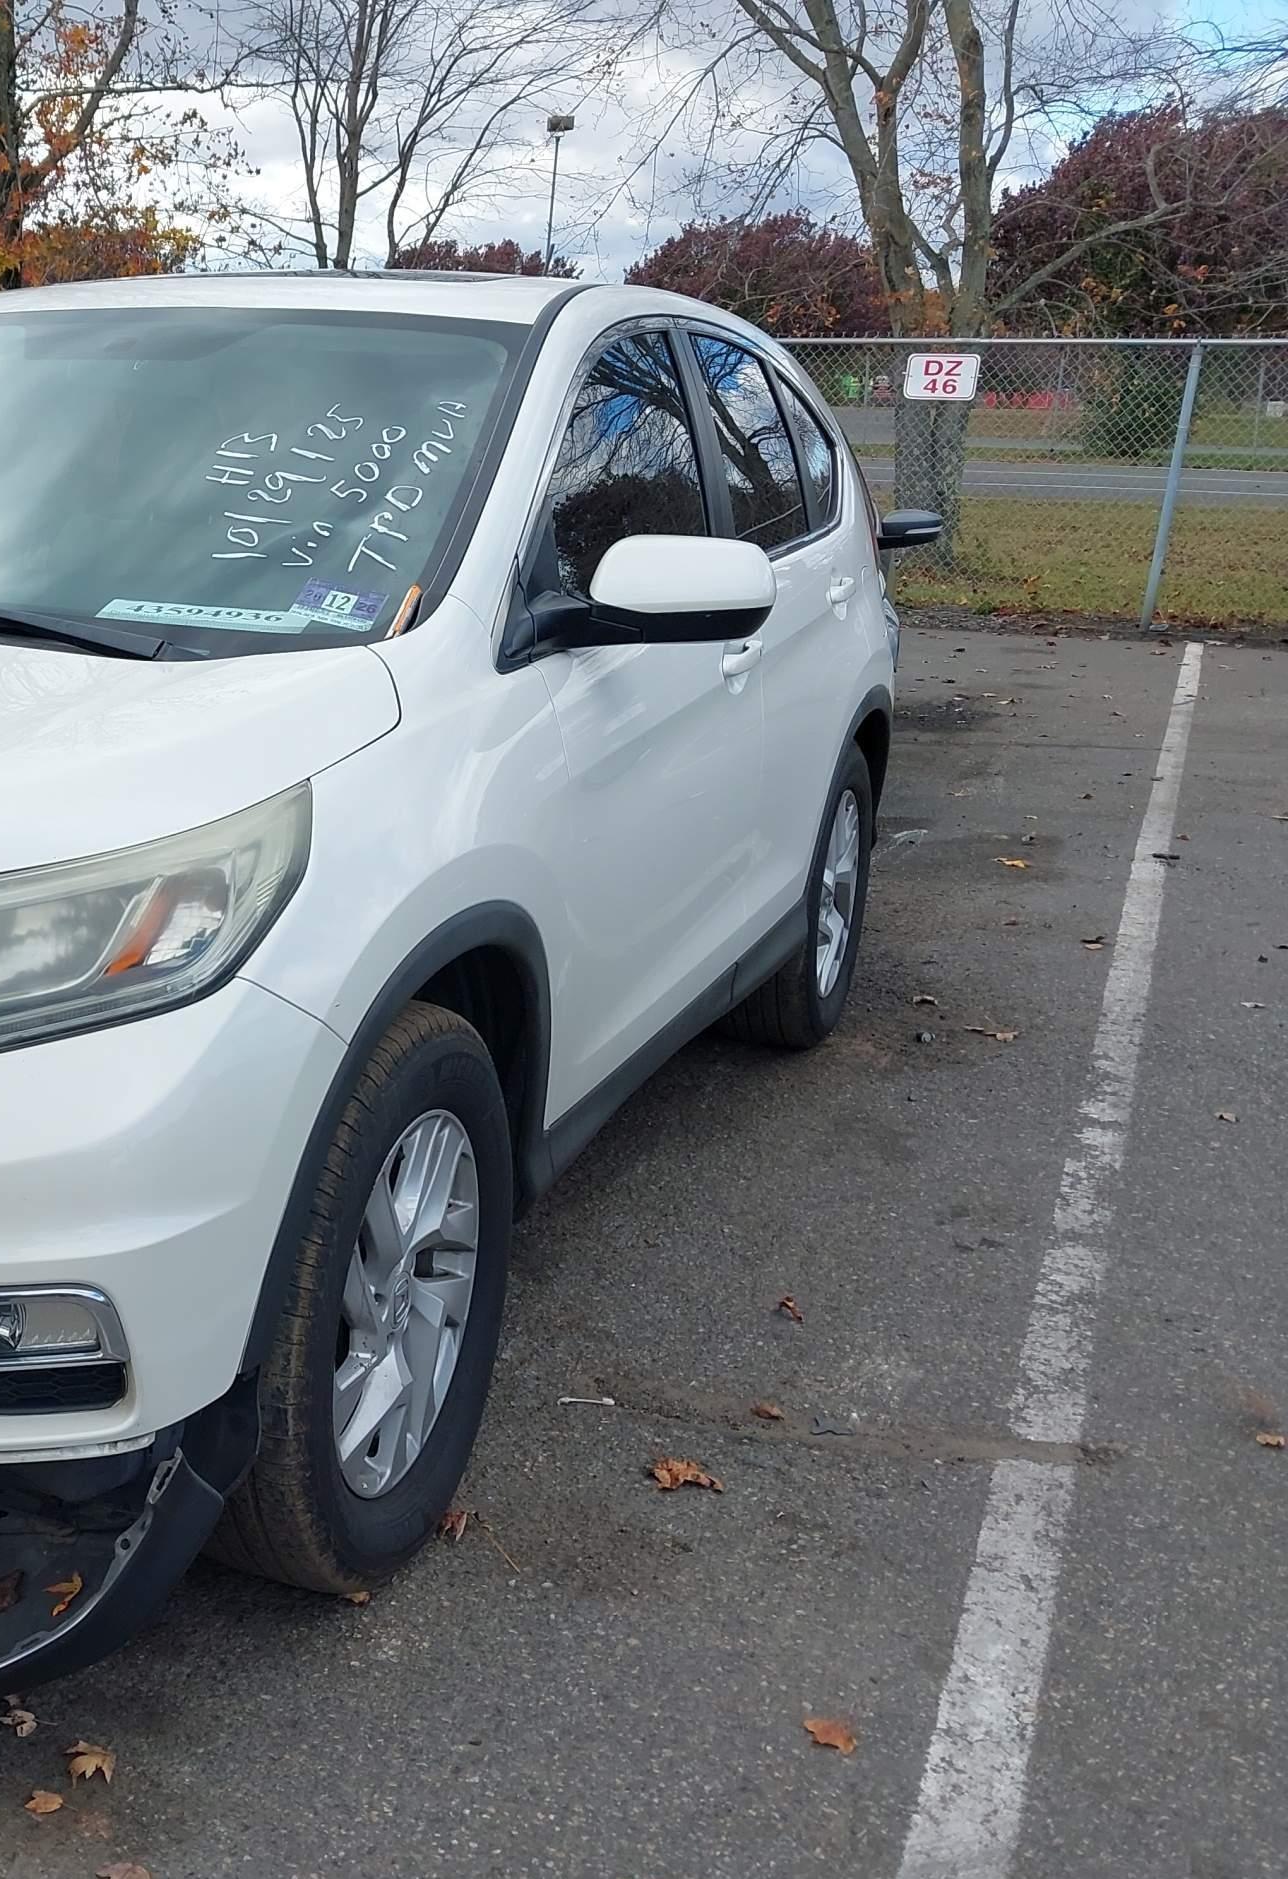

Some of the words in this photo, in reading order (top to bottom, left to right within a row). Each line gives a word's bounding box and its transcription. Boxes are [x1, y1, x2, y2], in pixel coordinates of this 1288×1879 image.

[924, 360, 963, 376] DZ
[923, 378, 958, 394] 46
[329, 426, 407, 504] 5000
[347, 485, 424, 573] TPD
[325, 593, 352, 611] 12
[126, 604, 283, 623] 43594936
